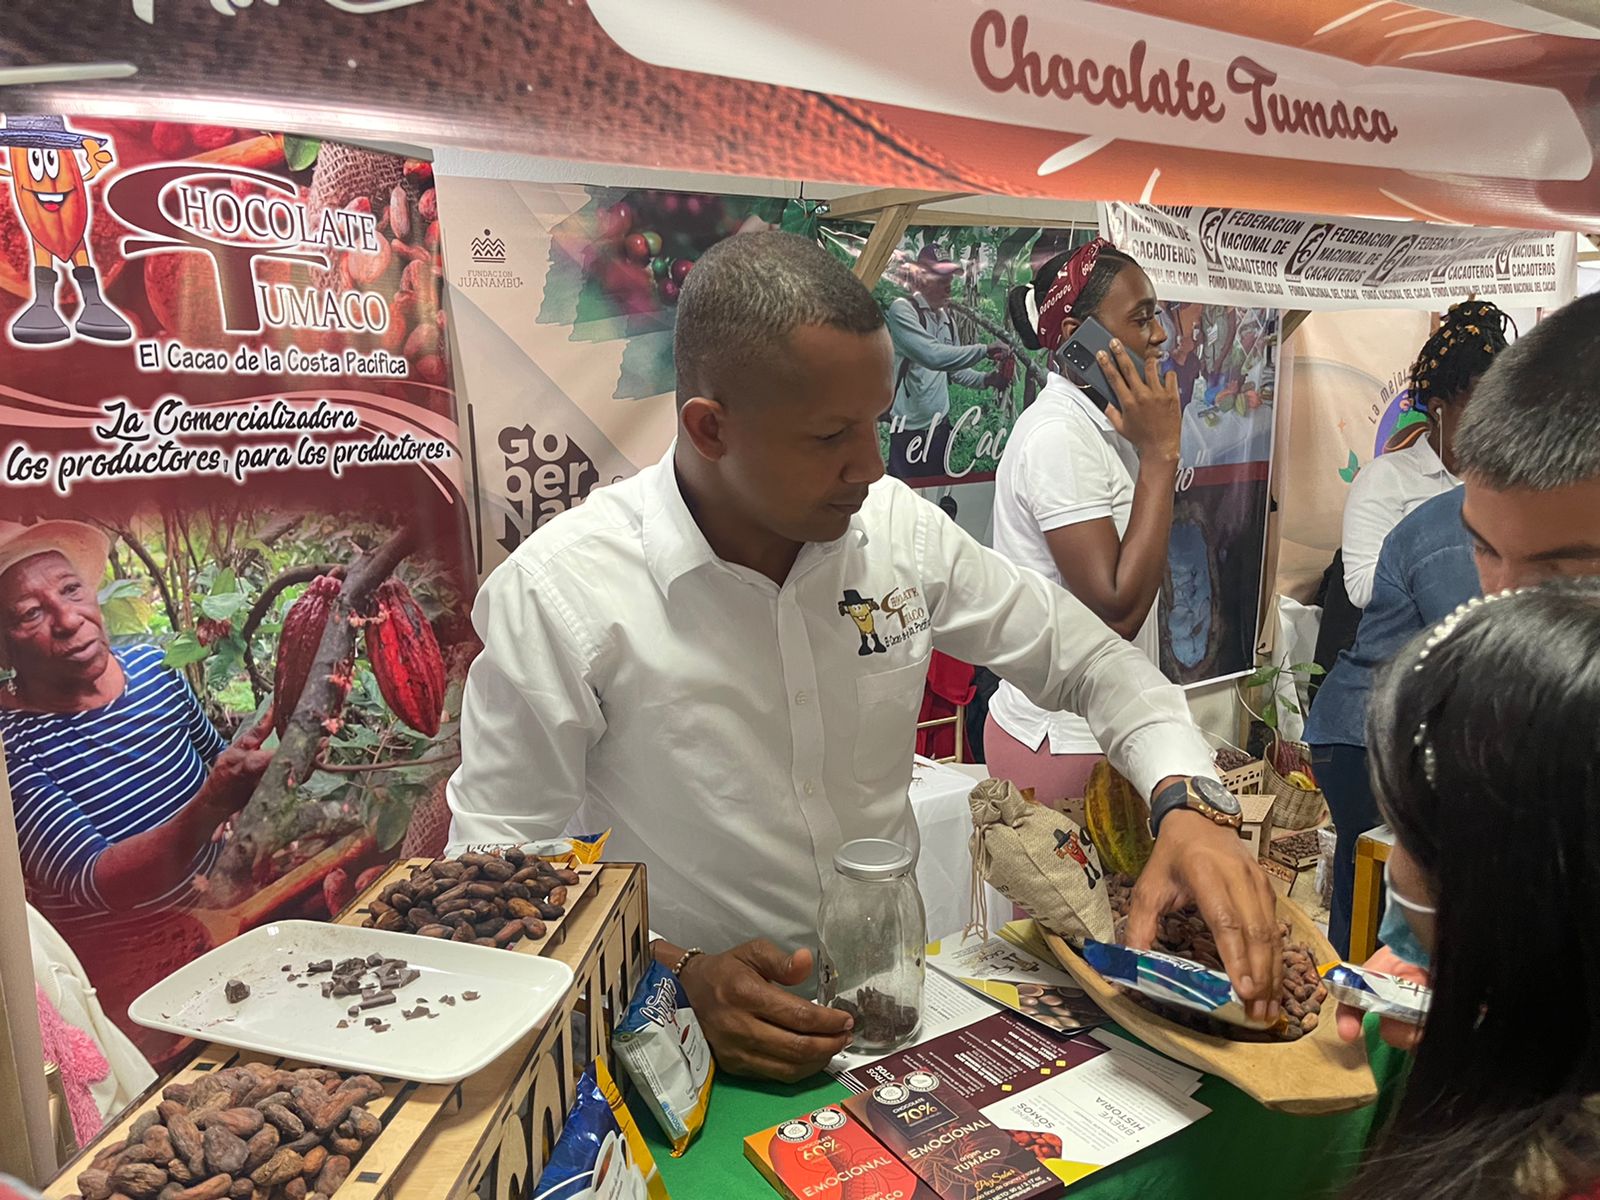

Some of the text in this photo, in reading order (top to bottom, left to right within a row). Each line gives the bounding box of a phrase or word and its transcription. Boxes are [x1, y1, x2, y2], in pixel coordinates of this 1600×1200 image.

[971, 9, 1398, 143] Chocolate Tumaco
[107, 166, 378, 251] CHOCOLATE
[1228, 211, 1305, 235] FEDERACION
[1221, 232, 1291, 255] NACIONAL DE
[1330, 227, 1398, 248] FEDERACION
[1132, 240, 1197, 265] CACAOTEROS
[1316, 247, 1366, 263] NACIONAL
[1363, 253, 1382, 265] DE
[1511, 244, 1544, 258] NACIONAL
[1546, 244, 1555, 257] DE
[1223, 256, 1278, 277] CACAOTEROS
[1304, 266, 1367, 282] CACAOTEROS
[1448, 264, 1494, 280] CACAOTEROS
[1511, 262, 1556, 277] CACAOTEROS
[124, 240, 388, 331] TUMACO
[1208, 275, 1228, 290] FONDO
[1228, 277, 1255, 292] NACIONAL
[1254, 281, 1266, 294] DEL
[139, 344, 160, 369] El
[167, 343, 228, 370] Cacao
[234, 347, 260, 370] de
[264, 348, 281, 371] la
[287, 349, 340, 373] Costa
[97, 399, 359, 438] La Comercializadora
[943, 406, 1008, 478] Cac
[6, 434, 451, 490] los productores, para los productores.
[892, 1097, 925, 1114] CHOCOLATE
[896, 1102, 938, 1124] 70%
[1017, 1102, 1056, 1129] SOMOS
[1096, 1096, 1146, 1132] HISTORIA
[1098, 1111, 1136, 1136] BREVE
[803, 1139, 841, 1161] 60%
[907, 1119, 992, 1160] EMOCIONAL
[953, 1148, 1001, 1173] TUMACO
[959, 1150, 982, 1163] origen
[802, 1156, 893, 1198] EMOCIONAL
